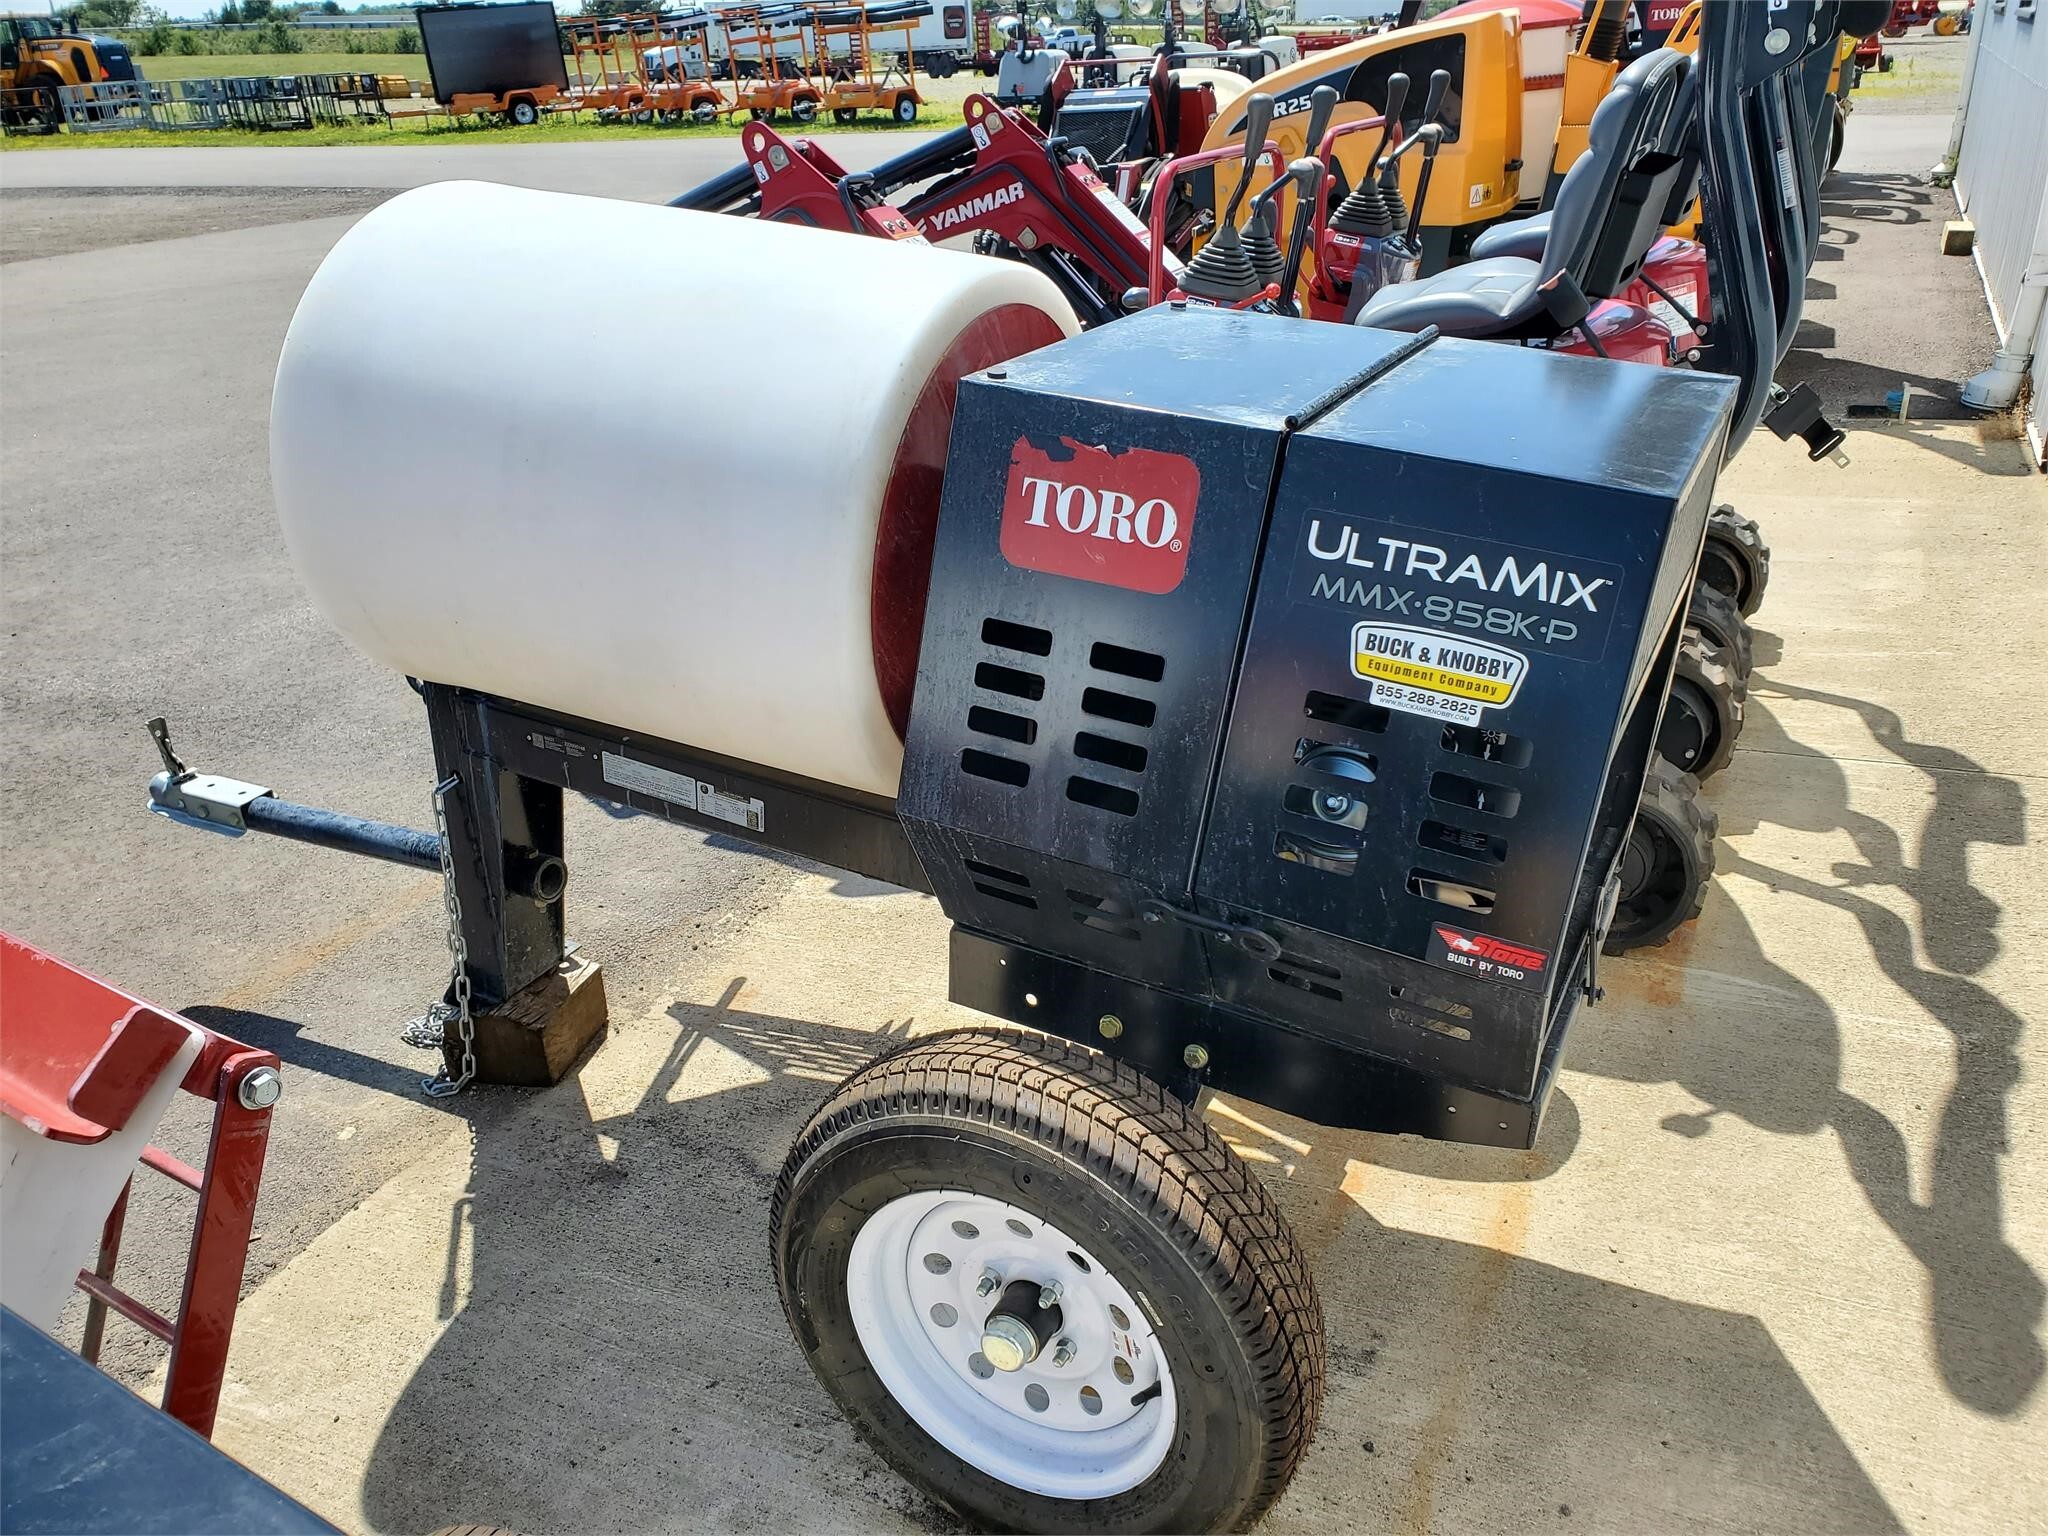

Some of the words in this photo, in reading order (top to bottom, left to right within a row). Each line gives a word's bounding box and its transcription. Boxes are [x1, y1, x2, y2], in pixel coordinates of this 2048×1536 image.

[928, 180, 1026, 232] YANMAR
[1022, 477, 1177, 549] TORO
[1364, 632, 1415, 660] BUCK
[1418, 647, 1432, 664] &
[1436, 647, 1514, 680] KNOBBY
[1367, 658, 1434, 682] Equipment
[1439, 673, 1498, 697] Company
[1375, 683, 1479, 716] 855-288-2825
[1379, 697, 1471, 722] WWW.BUCKANDKNOBBY.COM
[1447, 953, 1475, 966] BUILT
[1478, 961, 1493, 972] BY
[1498, 966, 1523, 980] TORO
[1471, 936, 1546, 970] Stone
